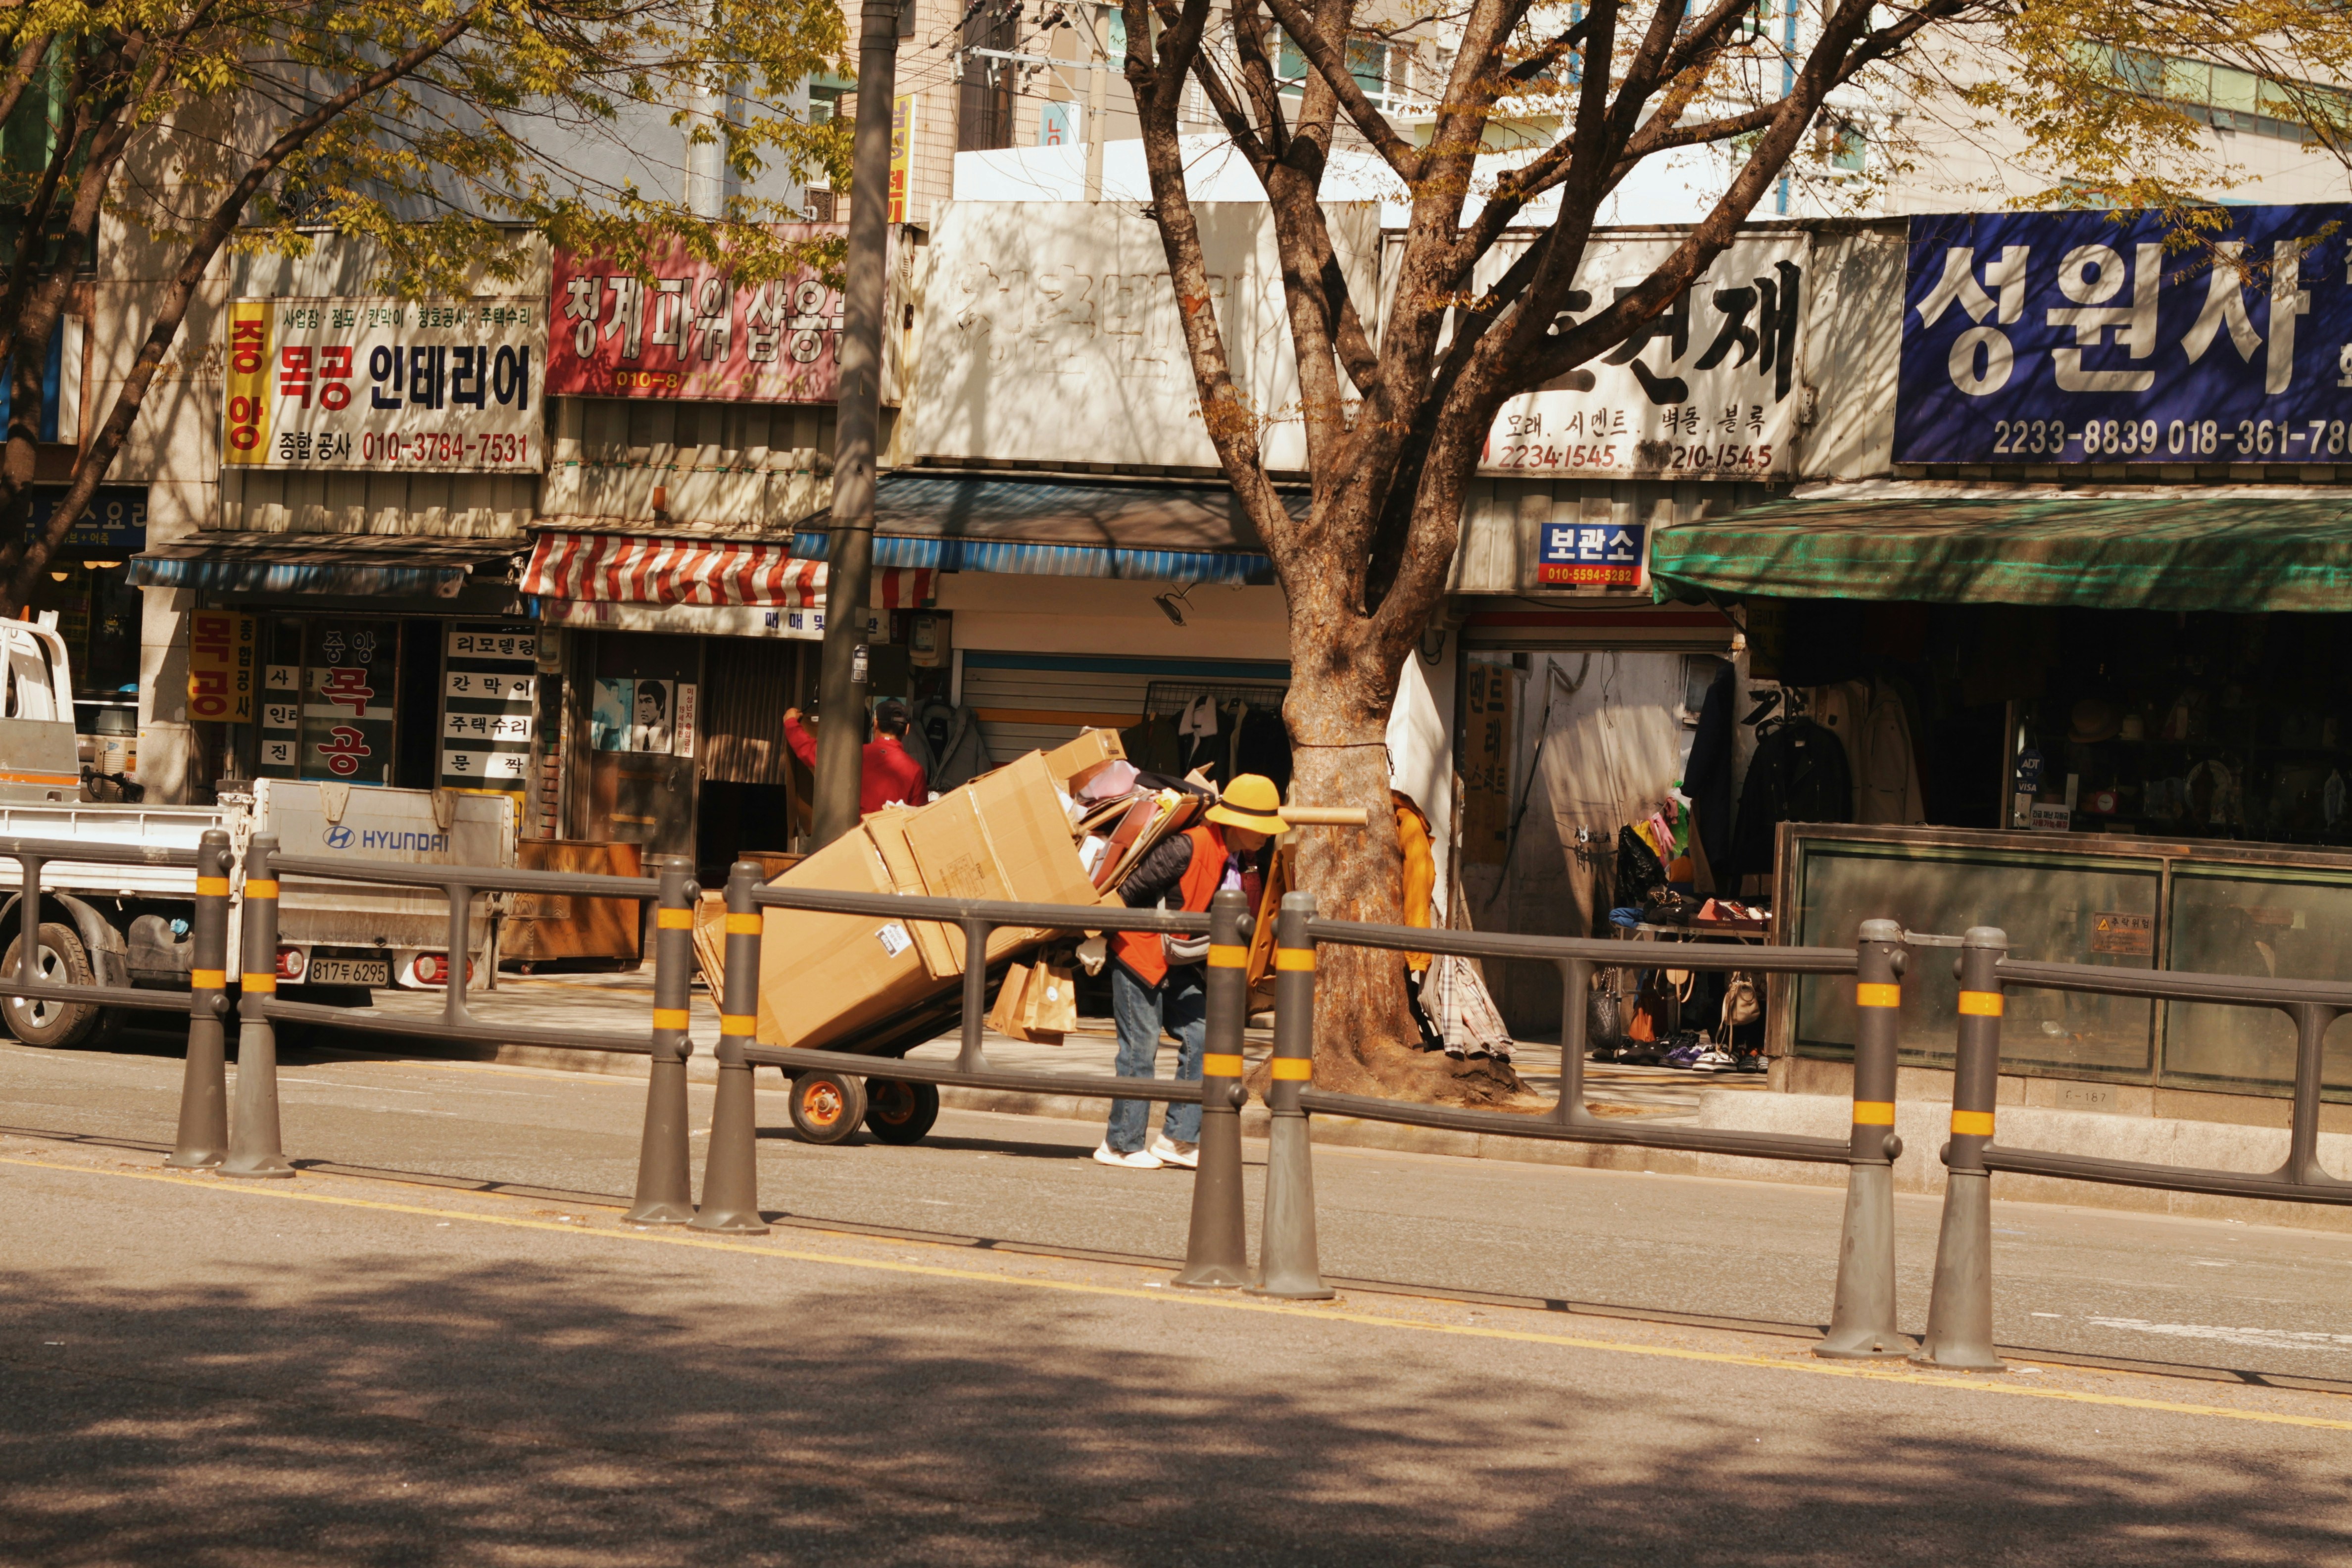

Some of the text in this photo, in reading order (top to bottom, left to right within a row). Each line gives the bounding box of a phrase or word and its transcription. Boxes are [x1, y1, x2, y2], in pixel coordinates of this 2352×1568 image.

[283, 306, 531, 329] 사업장 점포 칸막이 창호공사 주택수리
[1914, 240, 2311, 396] 성원사
[280, 344, 530, 411] 목공 인테리어
[362, 432, 528, 463] 010-3784-7531
[1993, 420, 2352, 454] 2233-8839 018-361-78
[1498, 443, 1772, 469] 2234-1545 210-1545
[1548, 528, 1634, 561] 보관소
[1548, 568, 1632, 582] 010-5594-5282
[322, 631, 376, 663] 중앙
[457, 636, 535, 656] 리모델링
[192, 617, 231, 717] 목공
[316, 666, 375, 776] 목공
[449, 716, 528, 735] 주택수리
[2020, 758, 2041, 770] ADT
[2018, 783, 2037, 792] VISA
[362, 830, 449, 853] HYUNDAI
